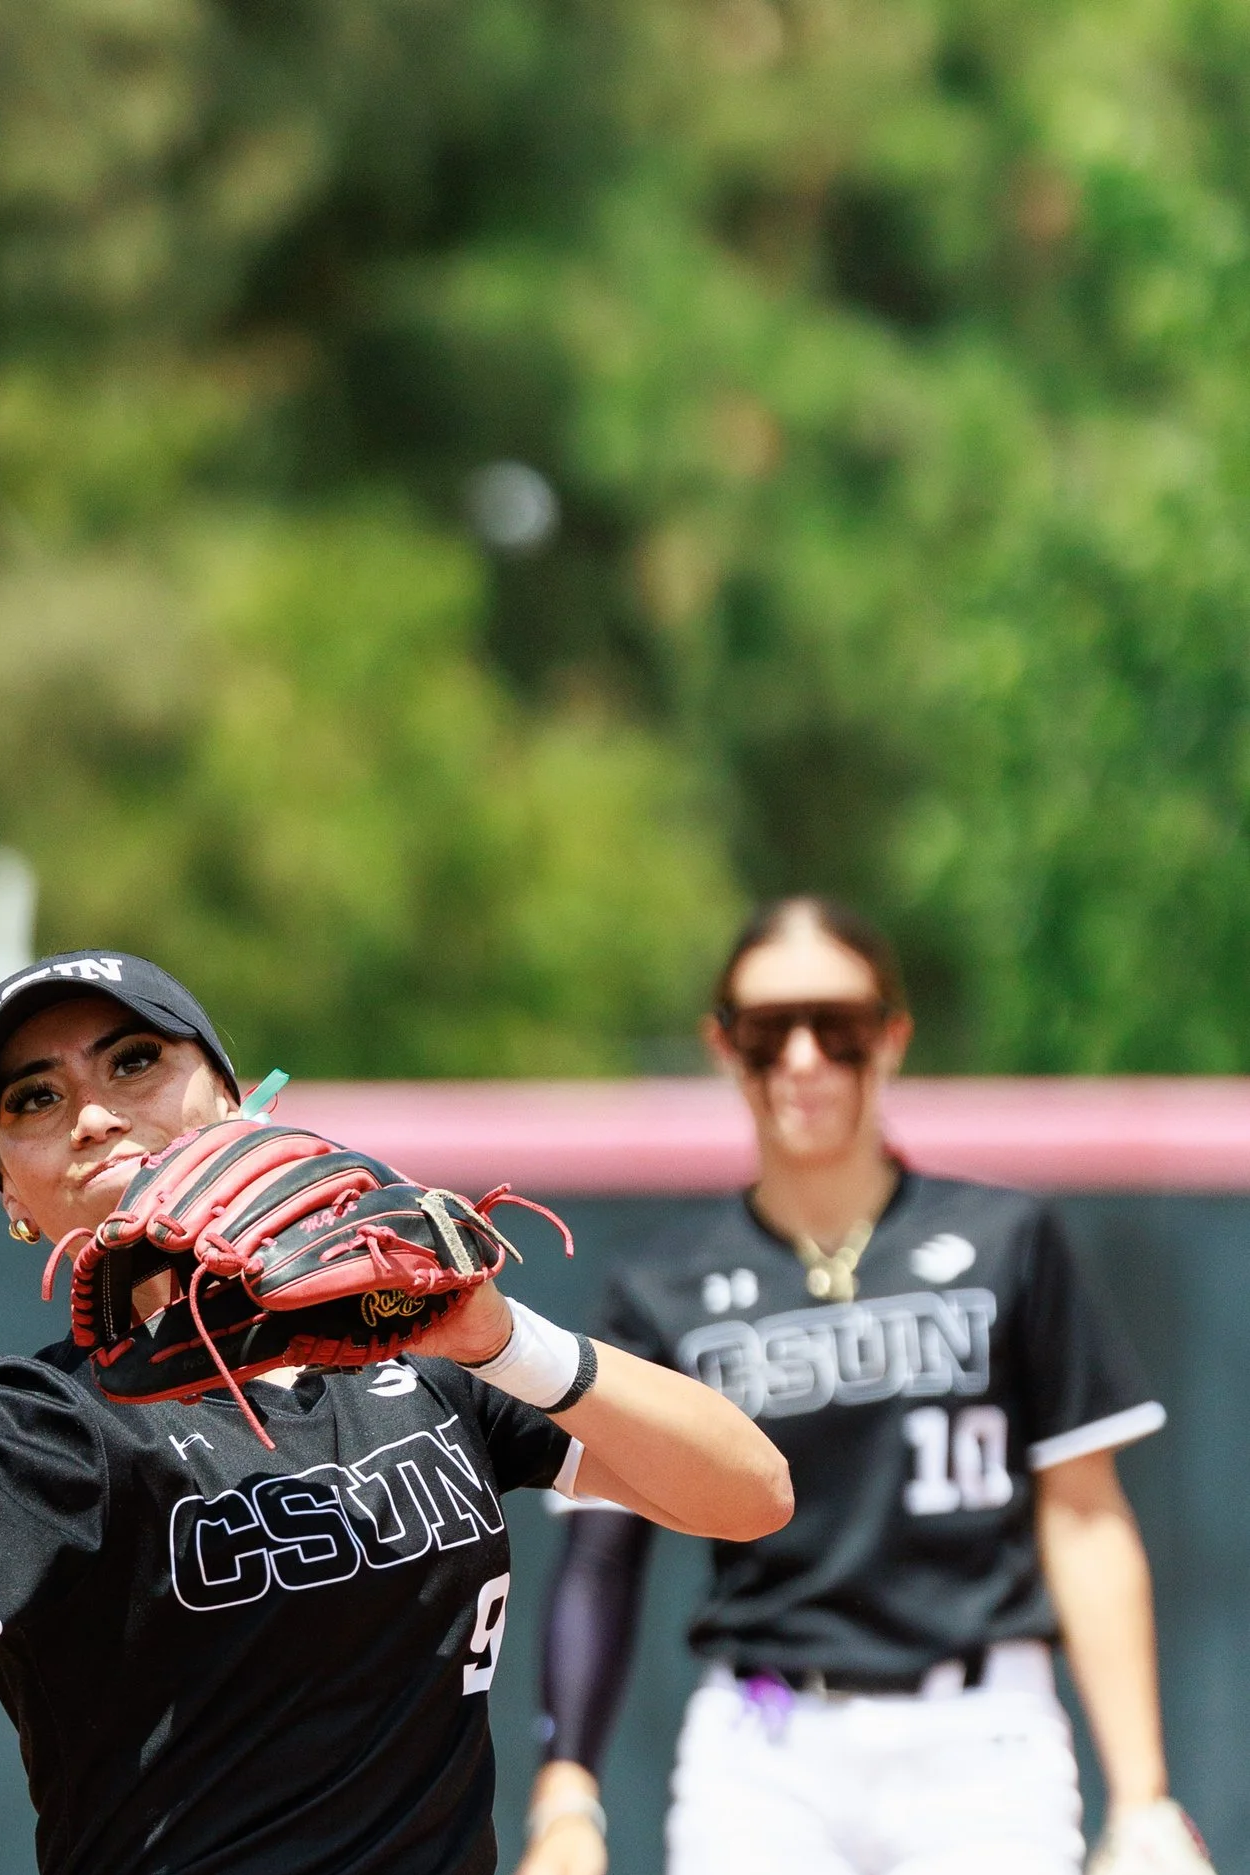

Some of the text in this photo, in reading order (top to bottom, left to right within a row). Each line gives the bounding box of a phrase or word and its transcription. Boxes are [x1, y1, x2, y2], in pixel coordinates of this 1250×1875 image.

[674, 1287, 997, 1420] CSUN
[170, 1414, 505, 1612] CSUN
[902, 1405, 1013, 1516] 10
[462, 1572, 511, 1696] 9
